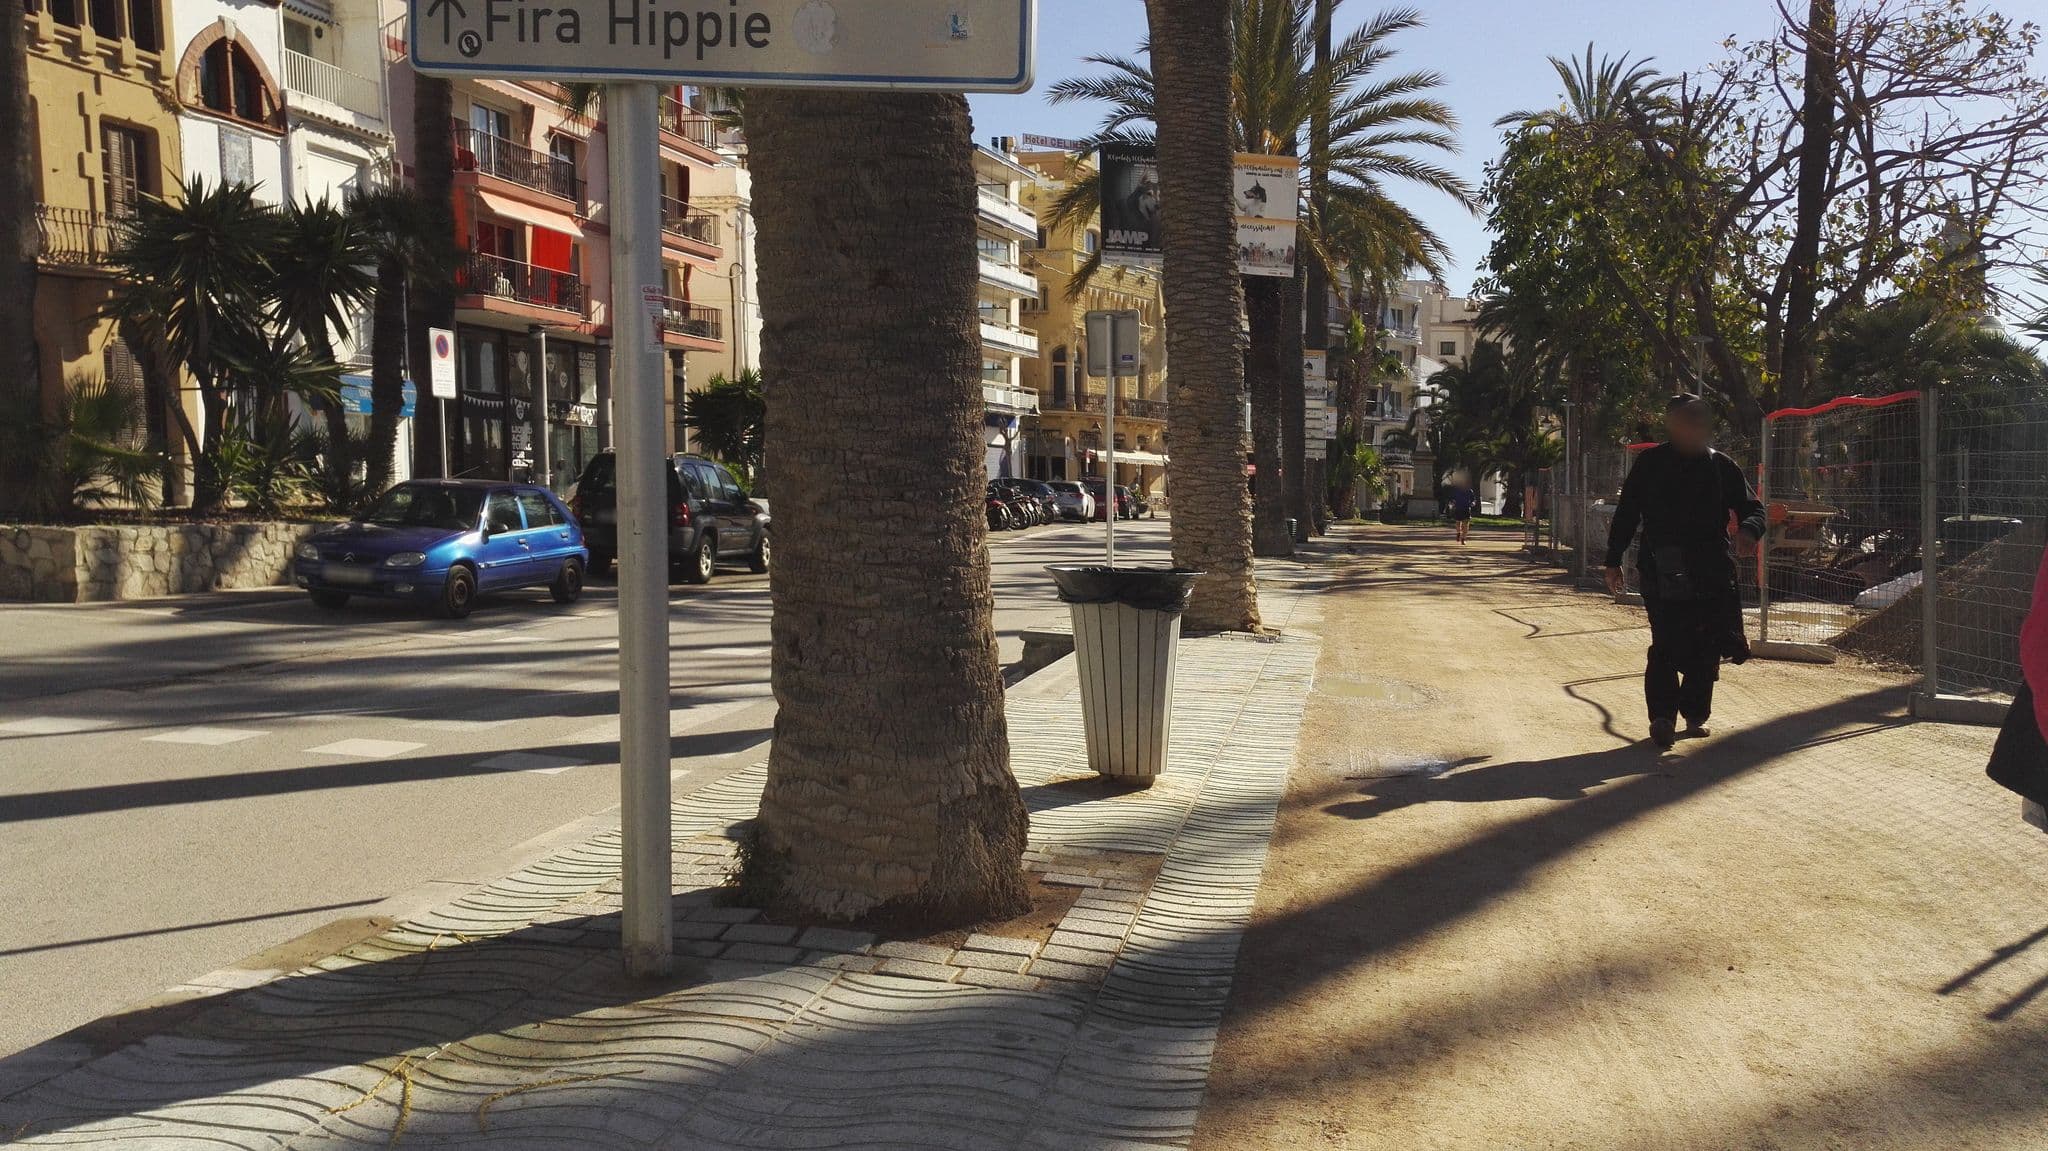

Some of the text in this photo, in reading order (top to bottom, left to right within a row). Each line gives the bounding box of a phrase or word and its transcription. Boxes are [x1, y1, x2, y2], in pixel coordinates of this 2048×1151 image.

[486, 0, 772, 60] Fira Hippie
[1025, 135, 1048, 146] Hotel
[1105, 229, 1149, 245] JAMP
